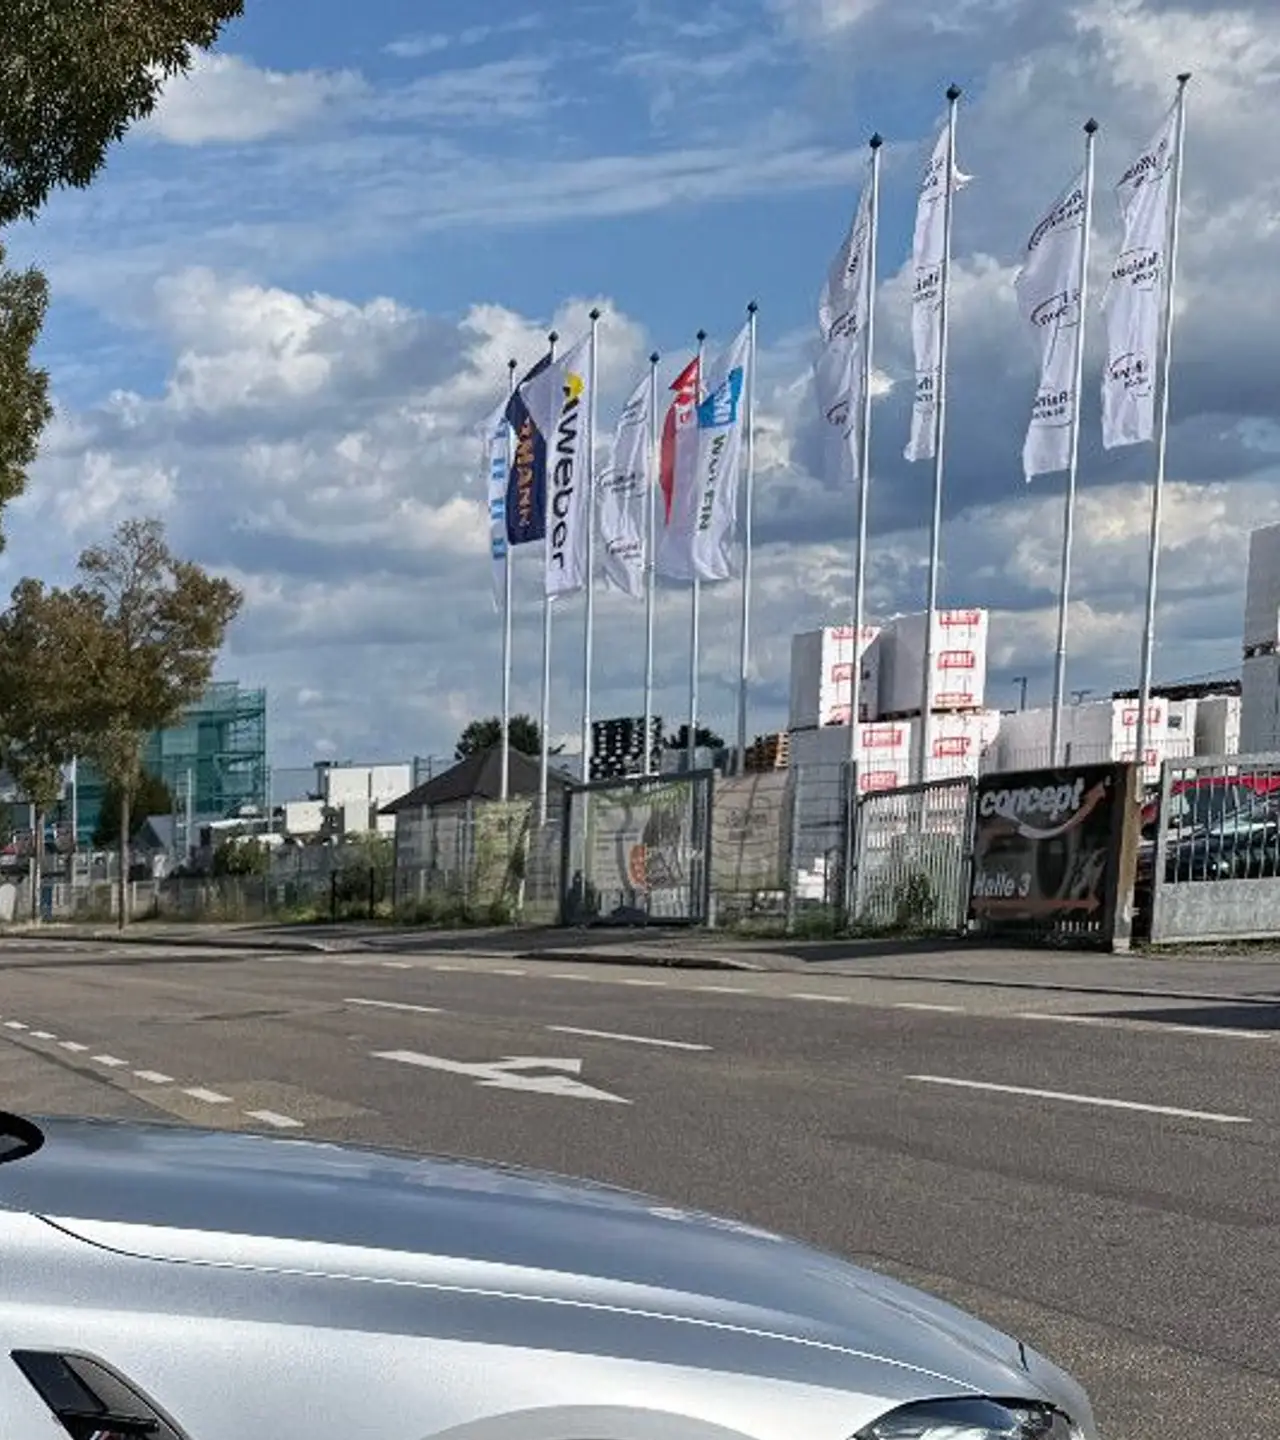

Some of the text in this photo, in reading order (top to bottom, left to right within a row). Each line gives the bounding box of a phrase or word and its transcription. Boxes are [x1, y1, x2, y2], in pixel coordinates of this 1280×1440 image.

[552, 412, 578, 569] weber
[980, 777, 1086, 822] concept
[972, 872, 1032, 898] Halle 3
